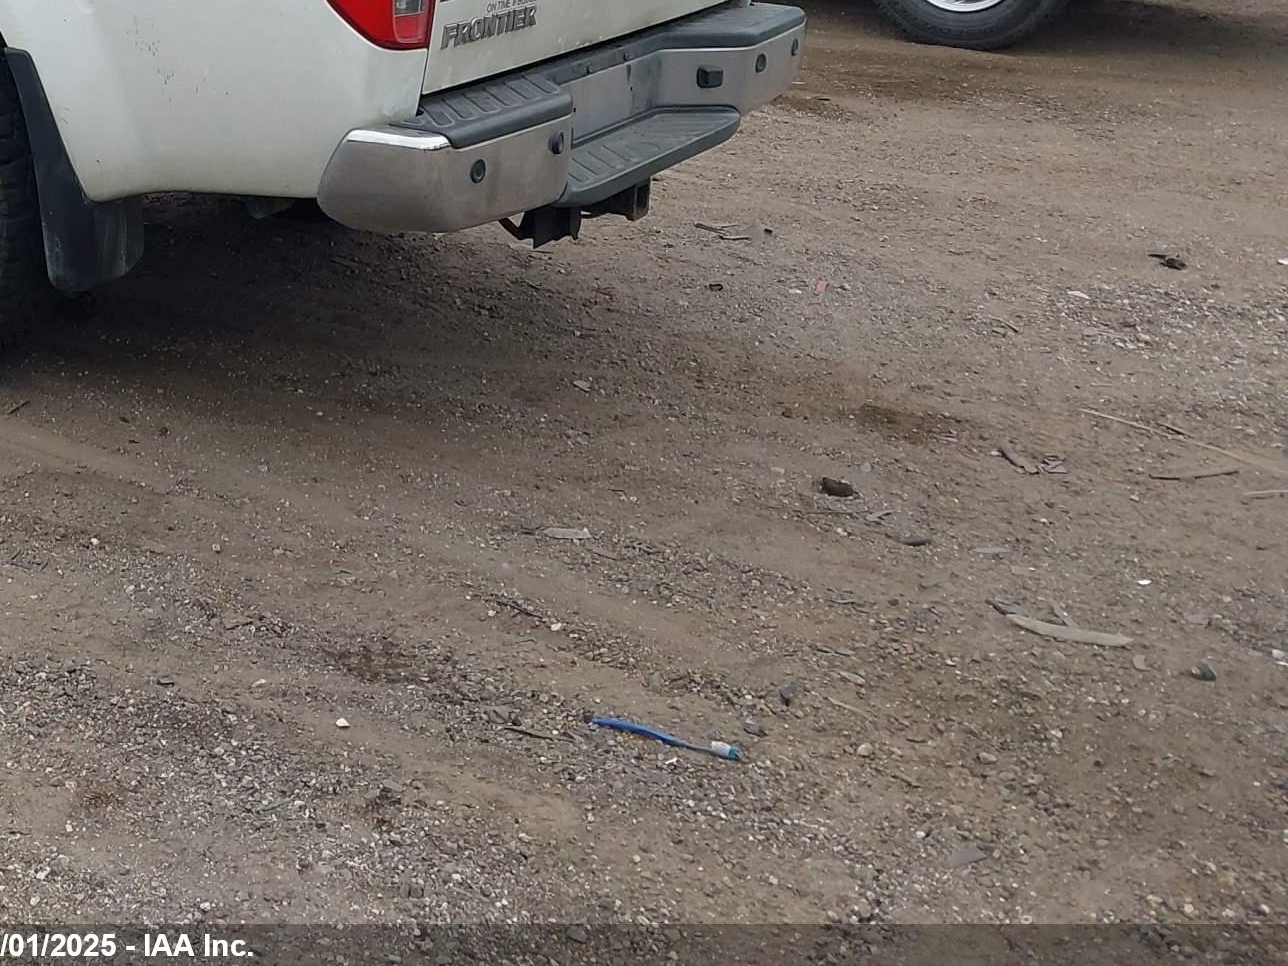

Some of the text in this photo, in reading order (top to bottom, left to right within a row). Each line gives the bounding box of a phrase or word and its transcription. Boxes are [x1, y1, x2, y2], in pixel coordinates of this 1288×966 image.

[487, 1, 495, 13] ON
[497, 0, 511, 11] TIME
[440, 5, 537, 51] FRONTIER
